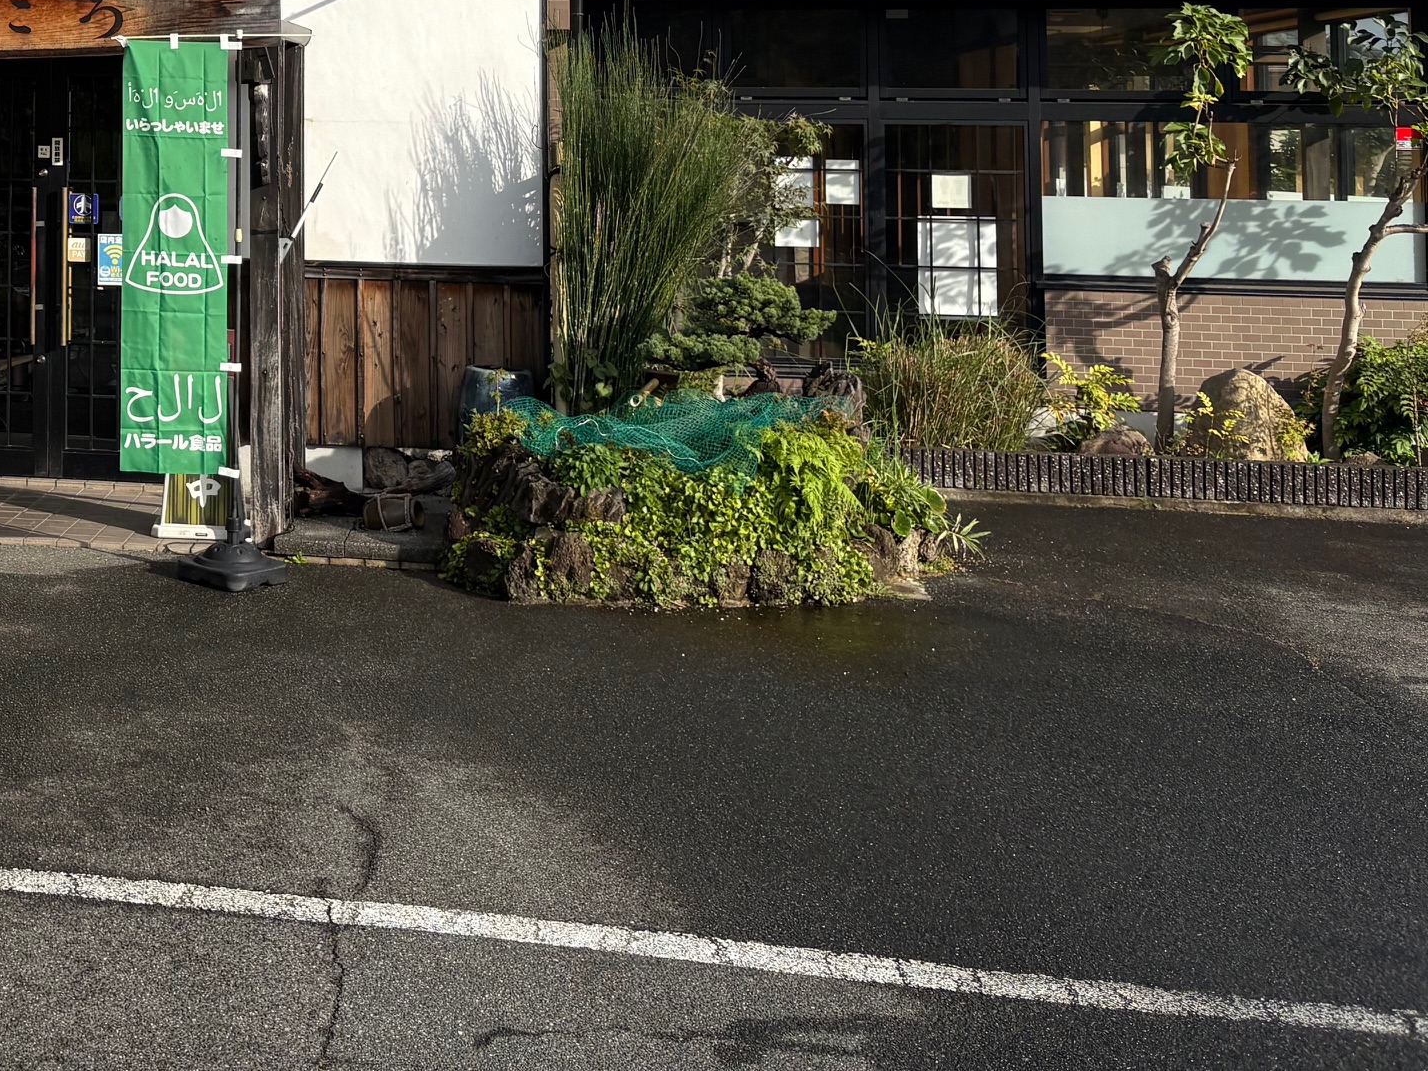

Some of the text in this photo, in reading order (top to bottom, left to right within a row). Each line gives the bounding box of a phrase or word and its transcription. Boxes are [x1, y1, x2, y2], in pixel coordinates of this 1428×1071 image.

[126, 117, 225, 135] いらっしゃいませ
[141, 250, 214, 269] HALAL
[146, 271, 202, 288] FOOD
[124, 432, 222, 452] ハラール食品
